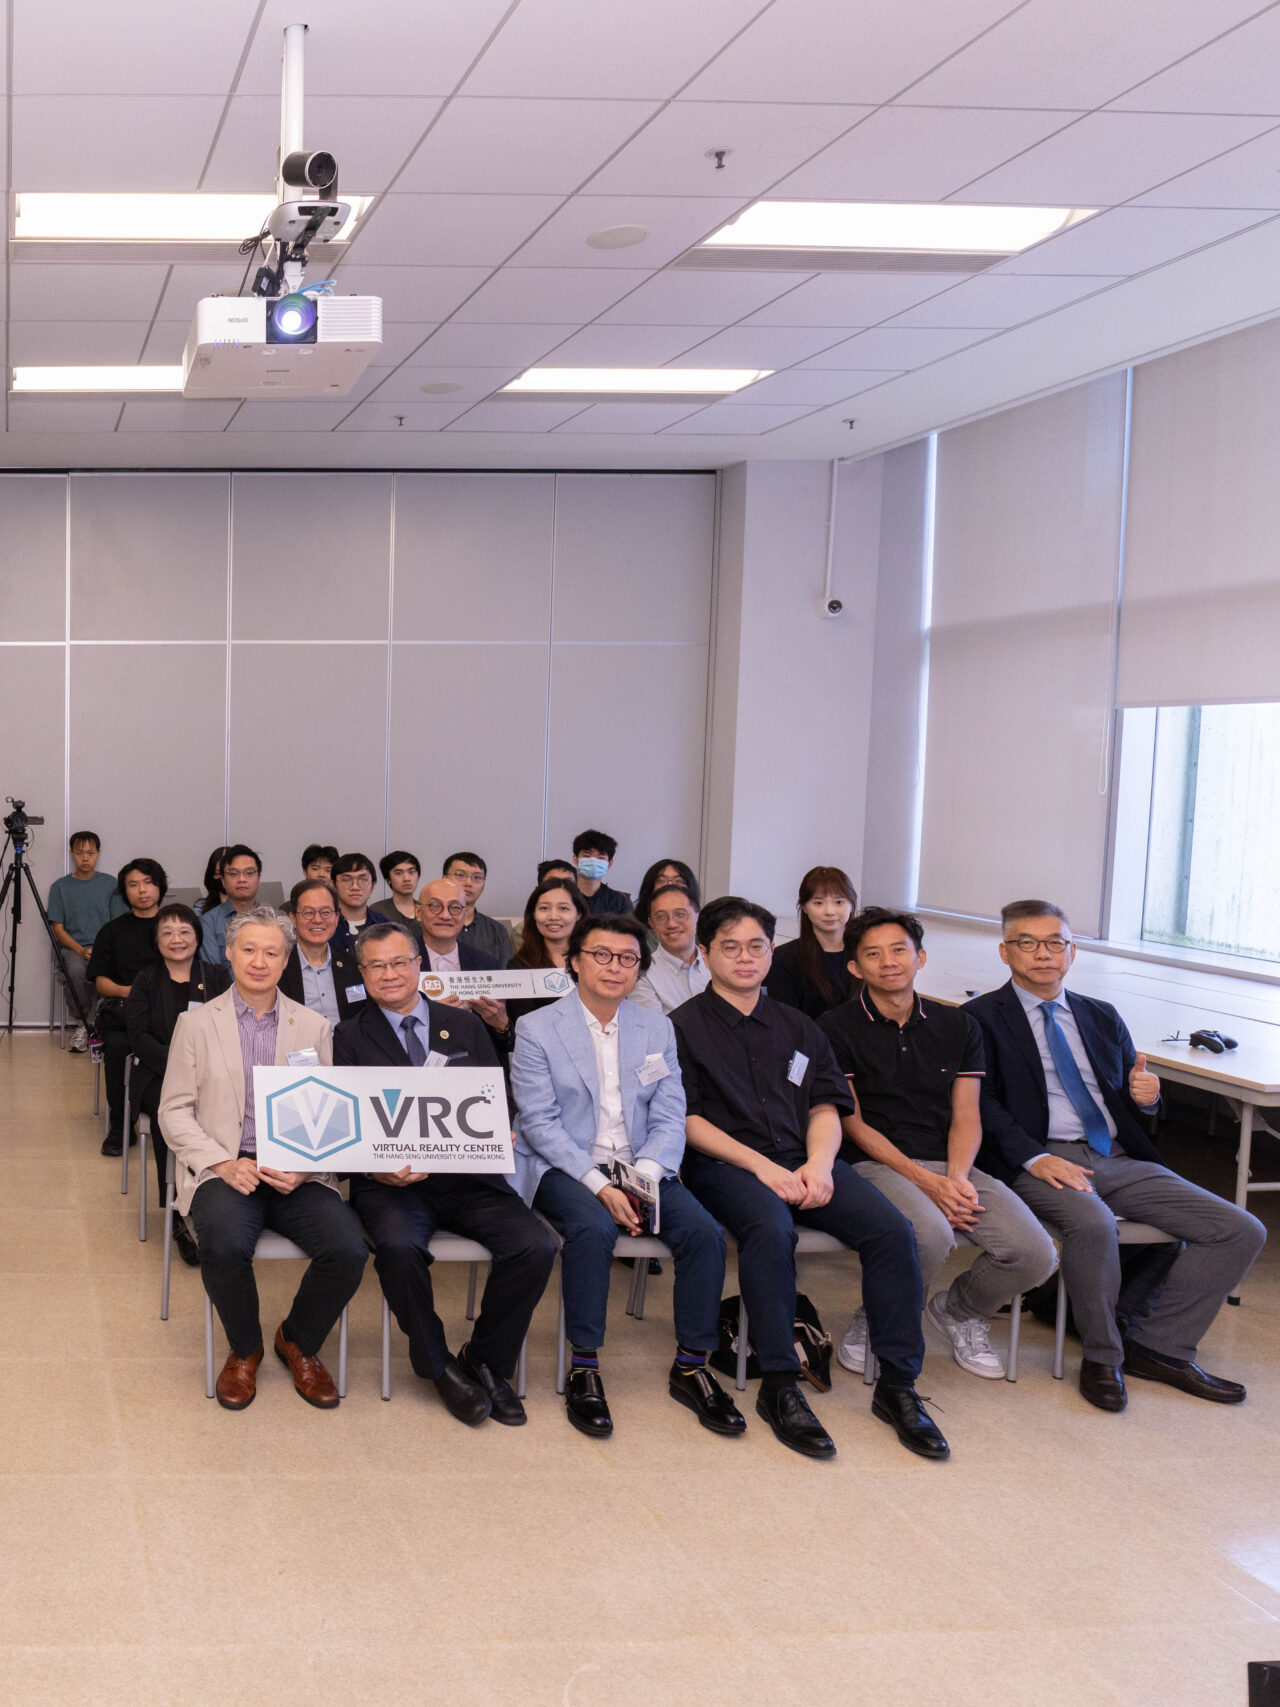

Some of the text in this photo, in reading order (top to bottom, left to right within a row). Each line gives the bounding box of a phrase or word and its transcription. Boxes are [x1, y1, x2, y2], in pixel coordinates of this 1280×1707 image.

[369, 1089, 494, 1139] VRC
[372, 1143, 504, 1153] VIRTUAL REALITY CENTRE
